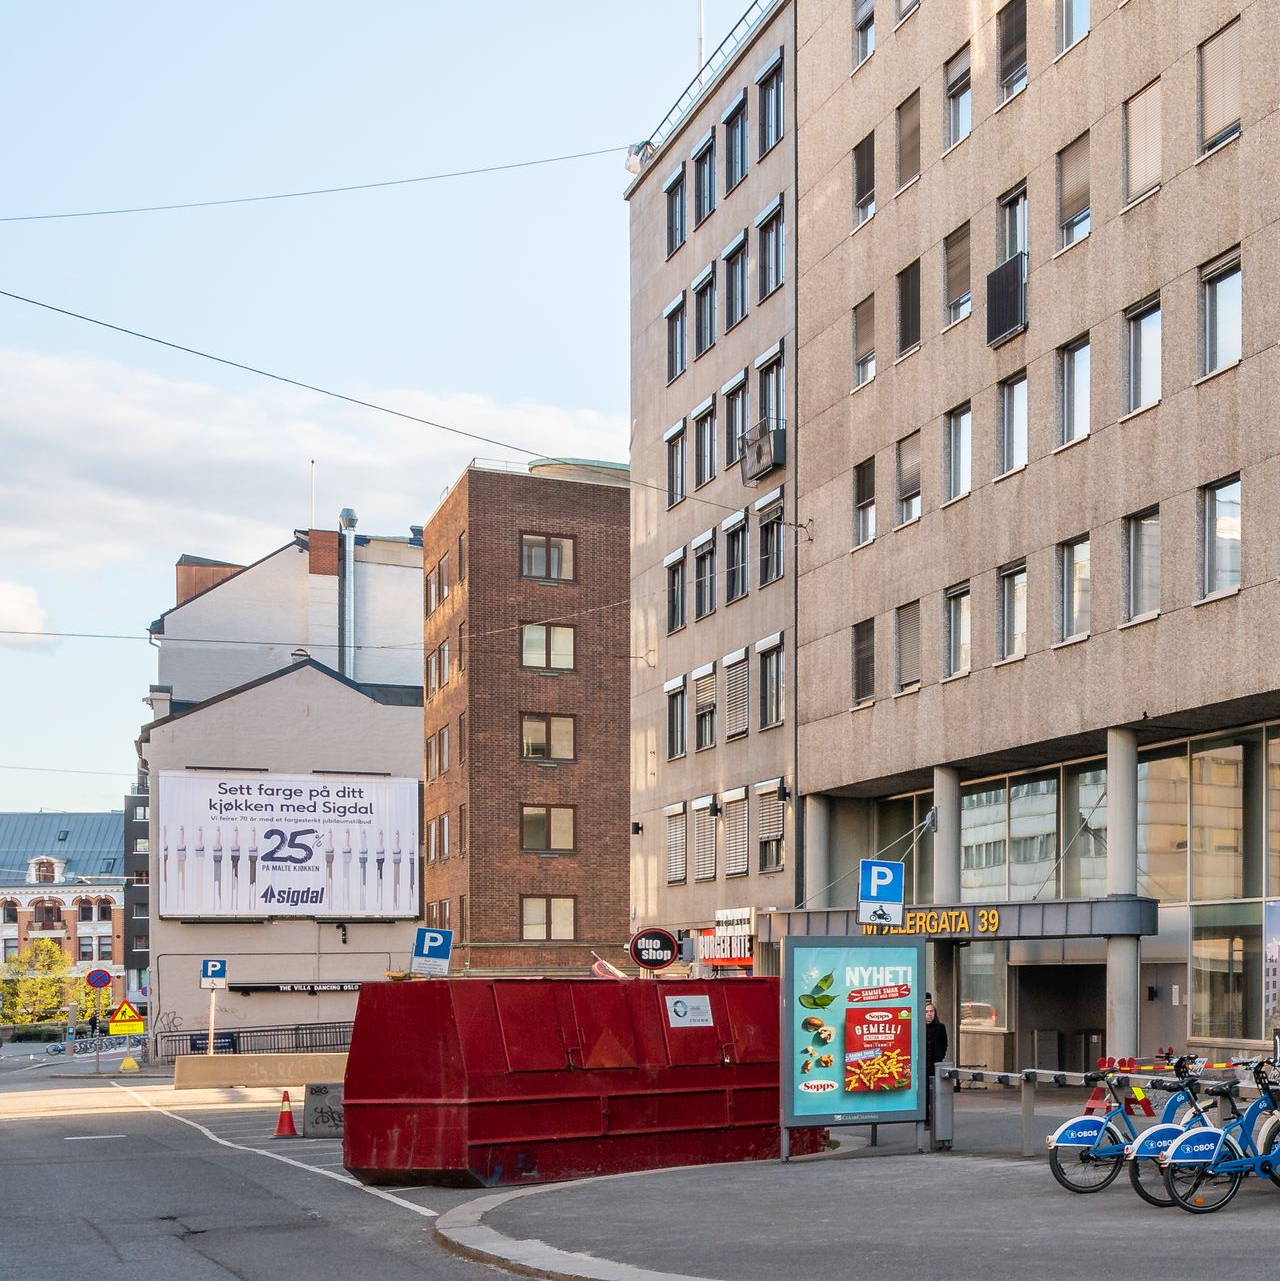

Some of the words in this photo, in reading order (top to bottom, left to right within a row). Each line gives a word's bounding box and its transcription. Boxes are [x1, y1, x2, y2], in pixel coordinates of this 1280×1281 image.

[218, 782, 252, 796] Sett
[257, 784, 303, 800] farge
[309, 786, 331, 801] på
[336, 787, 364, 799] ditt
[209, 798, 274, 814] kjøkken
[280, 801, 317, 813] med
[322, 802, 374, 817] Sigdal
[262, 864, 270, 872] PÅ
[870, 866, 894, 897] P
[277, 887, 325, 906] sigdal
[862, 911, 969, 935] MLLERGATA
[978, 909, 999, 933] 39
[423, 932, 444, 954] P
[637, 938, 660, 949] duo
[700, 935, 730, 958] BURGER
[732, 935, 750, 958] BITE
[641, 949, 671, 960] shop
[207, 961, 221, 976] P
[846, 966, 912, 987] NYHET!
[855, 1024, 901, 1035] GEMELLI
[803, 1082, 835, 1092] Sopps
[1077, 1129, 1098, 1138] OBOS
[1194, 1143, 1215, 1152] OBOS
